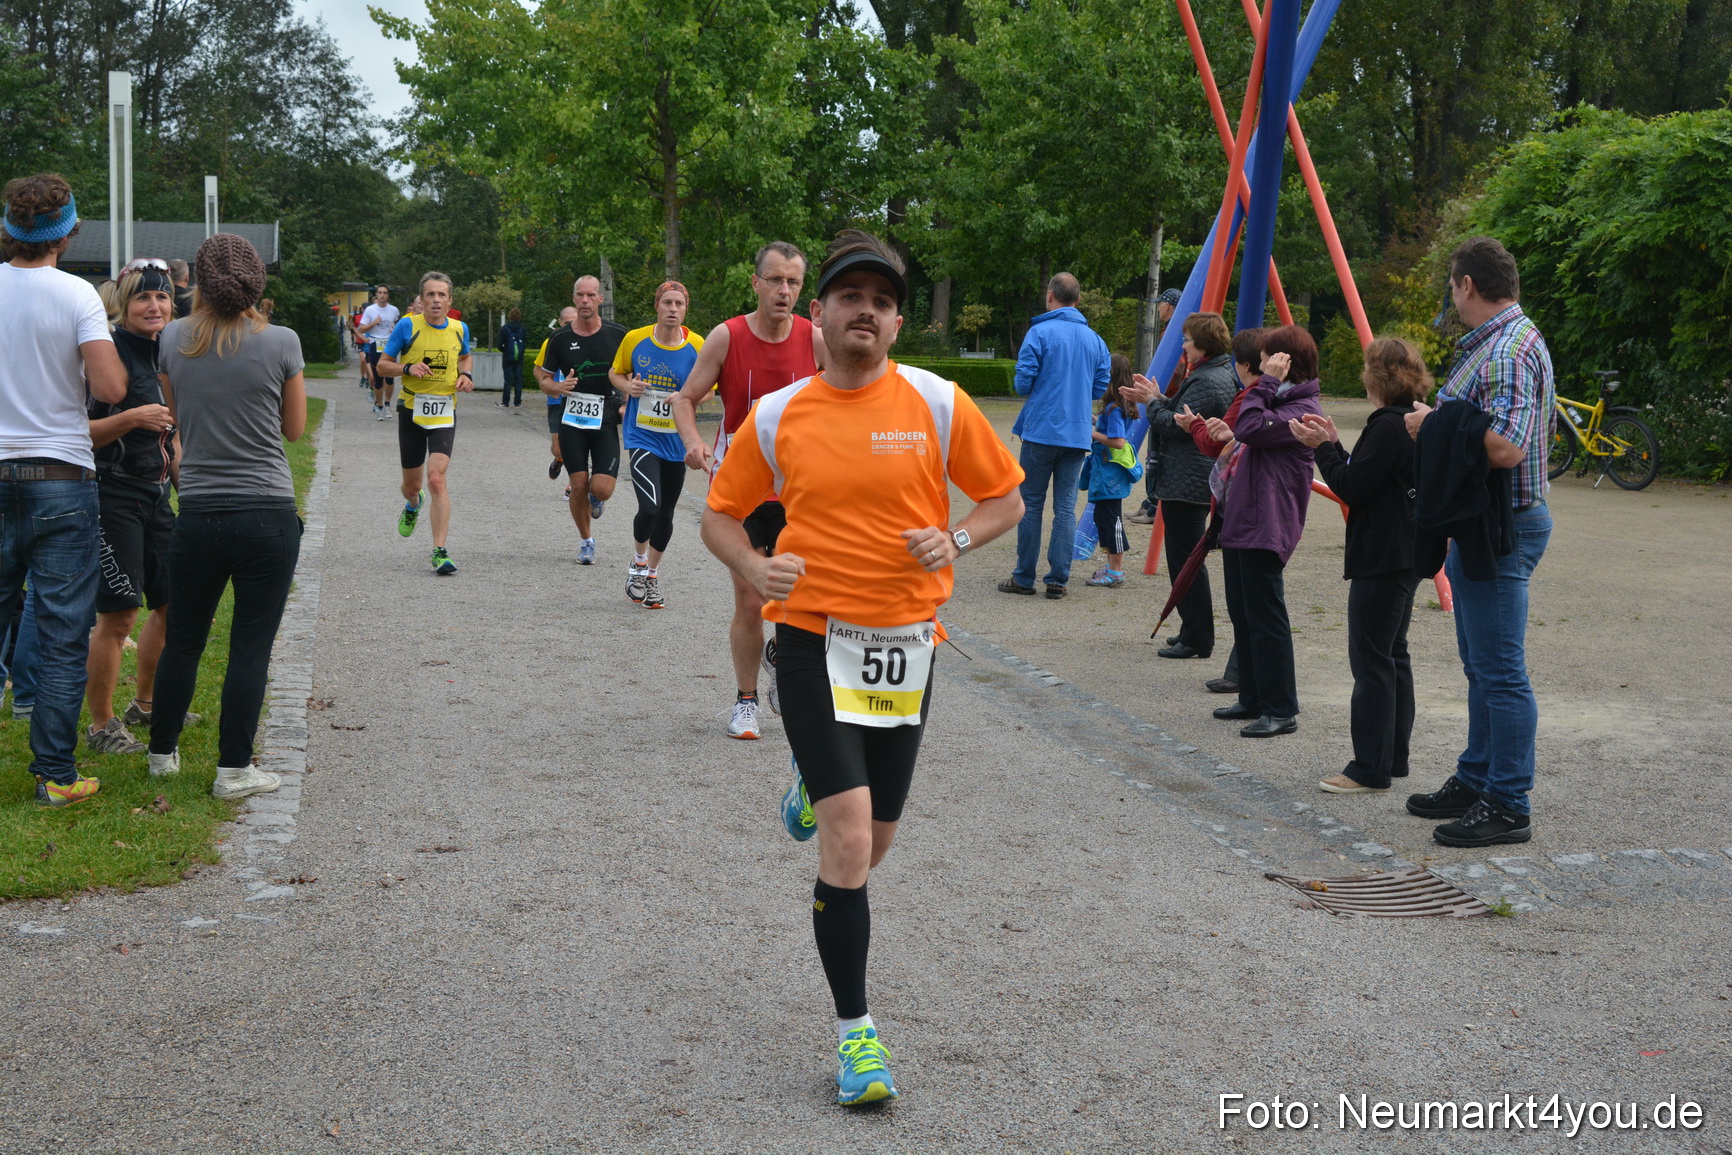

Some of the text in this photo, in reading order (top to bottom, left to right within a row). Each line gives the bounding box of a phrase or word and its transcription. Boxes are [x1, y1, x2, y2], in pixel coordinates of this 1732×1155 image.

[422, 402, 446, 415] 607
[569, 400, 600, 417] 2343
[652, 401, 671, 417] 49
[648, 418, 671, 428] Roland
[871, 633, 922, 643] Neumarkt
[862, 647, 907, 686] 50
[866, 696, 894, 712] Tim
